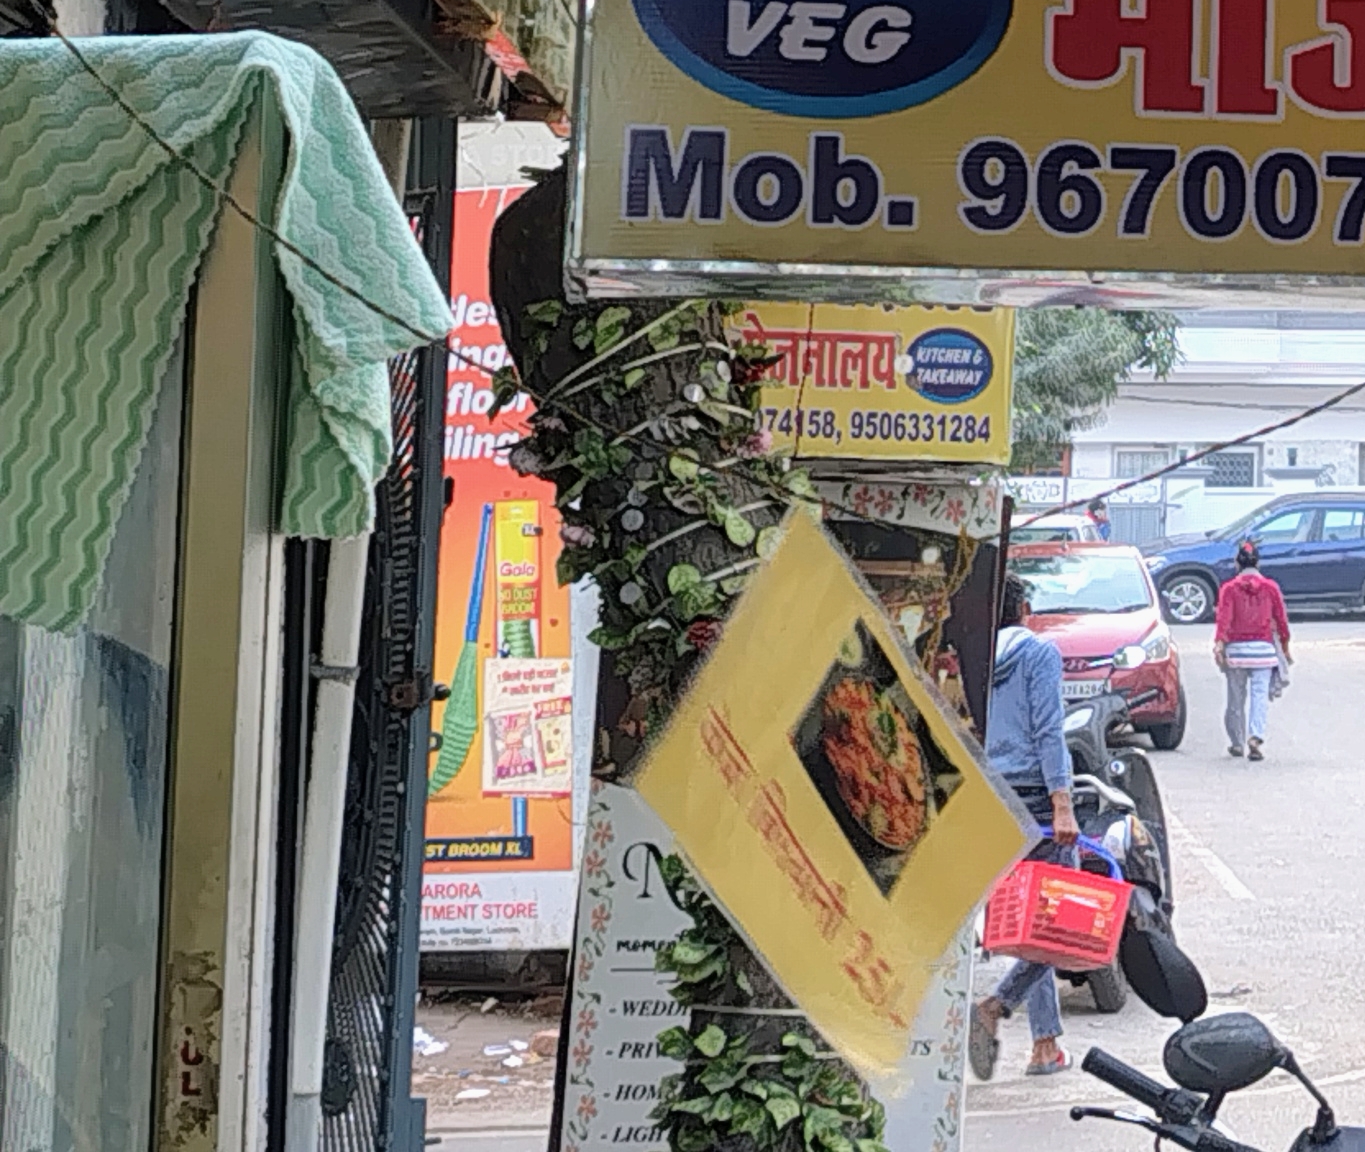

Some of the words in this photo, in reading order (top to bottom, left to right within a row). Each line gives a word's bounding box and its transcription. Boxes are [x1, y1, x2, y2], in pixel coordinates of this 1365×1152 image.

[626, 128, 917, 230] Mob.
[916, 345, 971, 364] KITCHEN
[917, 366, 983, 387] TAKEAWAY
[850, 412, 991, 444] 9506331284
[447, 841, 502, 857] BROOM
[505, 840, 523, 856] XL
[482, 903, 538, 920] STORE
